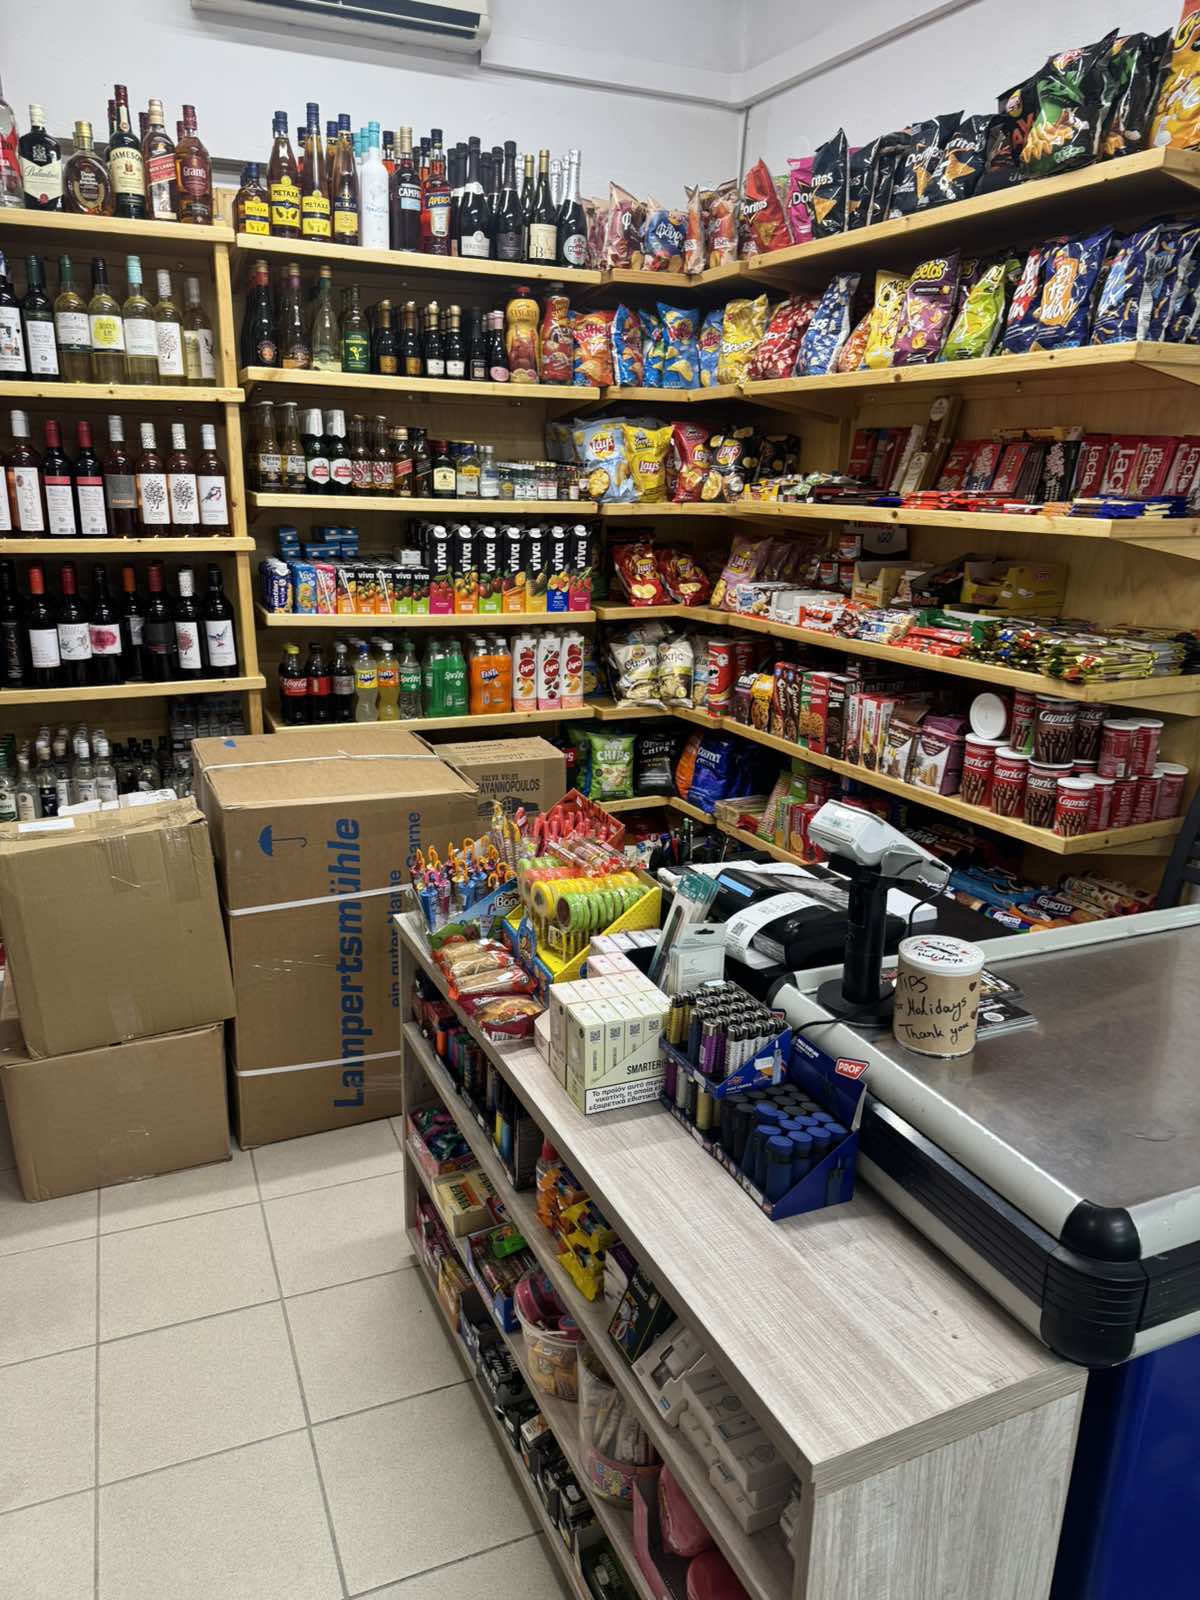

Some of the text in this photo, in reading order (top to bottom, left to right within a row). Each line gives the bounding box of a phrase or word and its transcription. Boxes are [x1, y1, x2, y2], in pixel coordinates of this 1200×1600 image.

[273, 189, 299, 198] METAXA
[743, 199, 769, 216] oritos
[435, 543, 447, 572] viva
[460, 543, 472, 572] viva
[484, 543, 496, 572] viva
[508, 543, 520, 572] viva
[530, 543, 541, 571] viva
[552, 543, 564, 571] viva
[574, 541, 587, 568] viva
[358, 572, 374, 580] viva
[396, 572, 411, 580] viva
[1039, 711, 1079, 727] Caprice
[596, 751, 631, 763] CHIPS
[994, 764, 1026, 780] Caprice
[327, 818, 373, 1107] Lampertsmühle
[907, 996, 967, 1022] Holidays
[899, 1021, 970, 1044] Thank you
[837, 1061, 863, 1076] PROF
